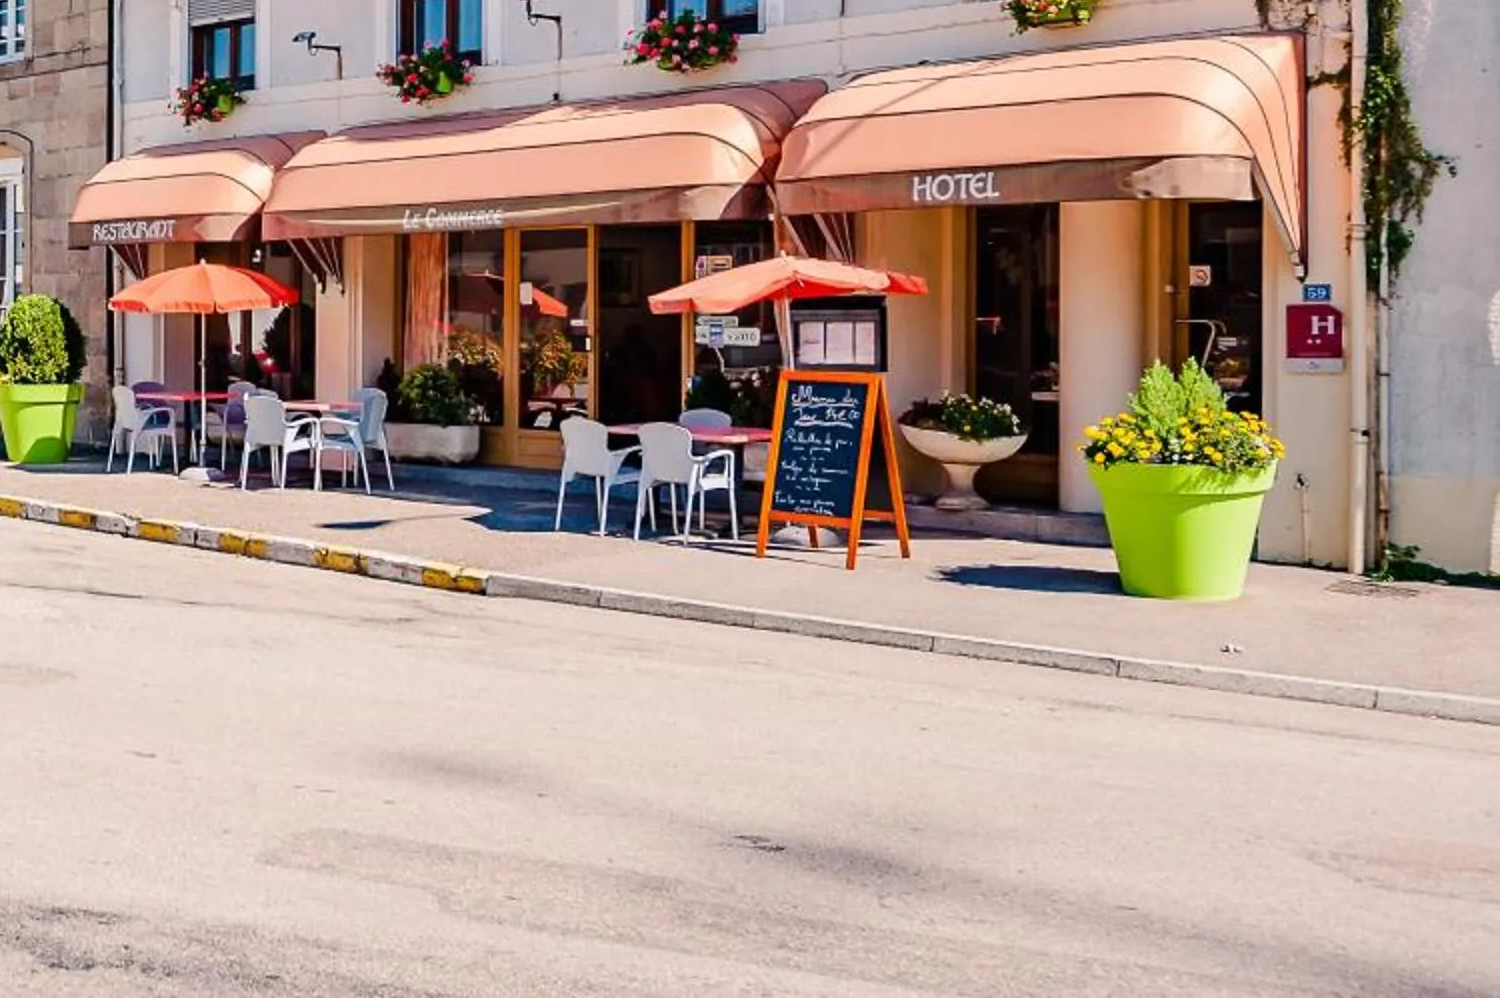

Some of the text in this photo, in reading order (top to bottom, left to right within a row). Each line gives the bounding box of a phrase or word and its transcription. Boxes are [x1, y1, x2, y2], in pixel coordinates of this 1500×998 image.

[913, 172, 1000, 201] HOTEL
[93, 220, 176, 241] RESTAURANT
[1311, 315, 1335, 335] H
